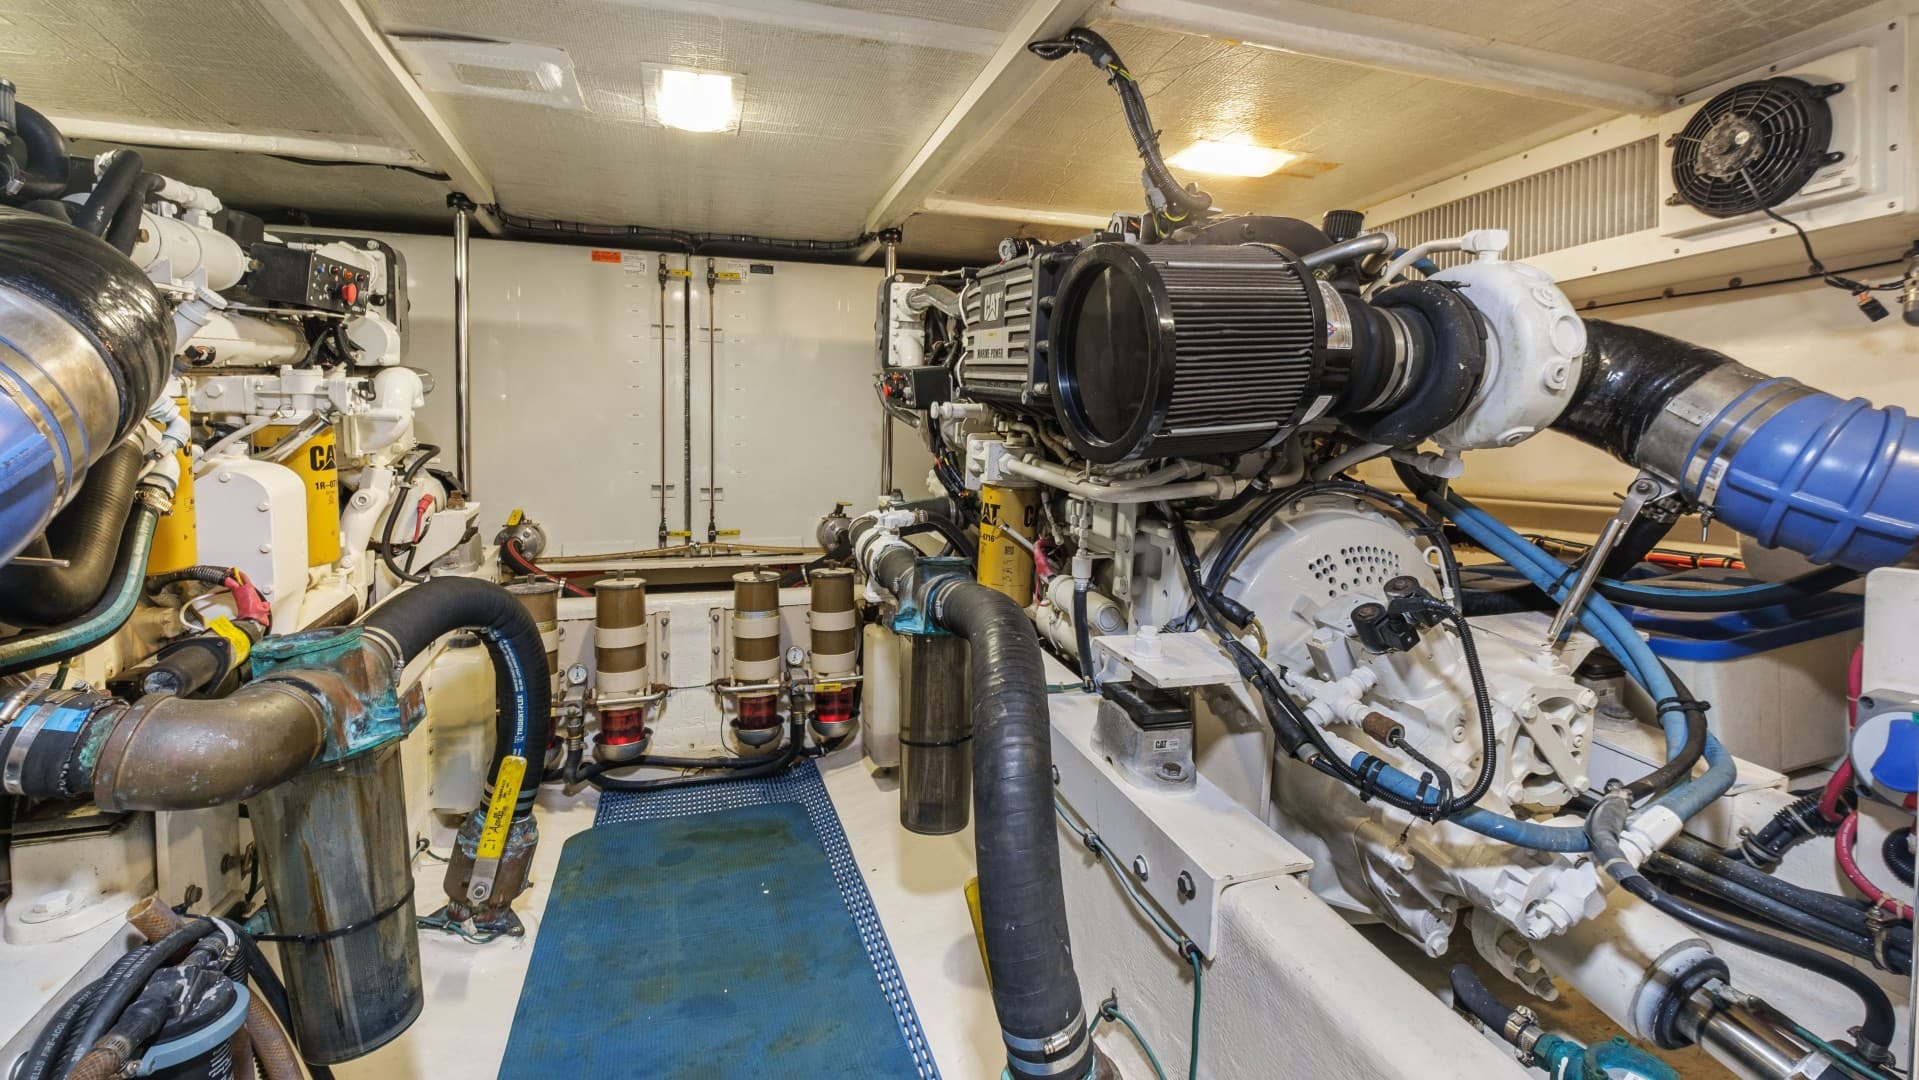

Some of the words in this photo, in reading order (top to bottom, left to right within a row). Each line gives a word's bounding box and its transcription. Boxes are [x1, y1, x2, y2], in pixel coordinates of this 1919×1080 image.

[984, 292, 1003, 322] CAT
[310, 445, 337, 472] CA
[981, 502, 1001, 527] AT
[516, 693, 525, 736] TRIDENT-FLEX
[1155, 740, 1168, 749] CAT
